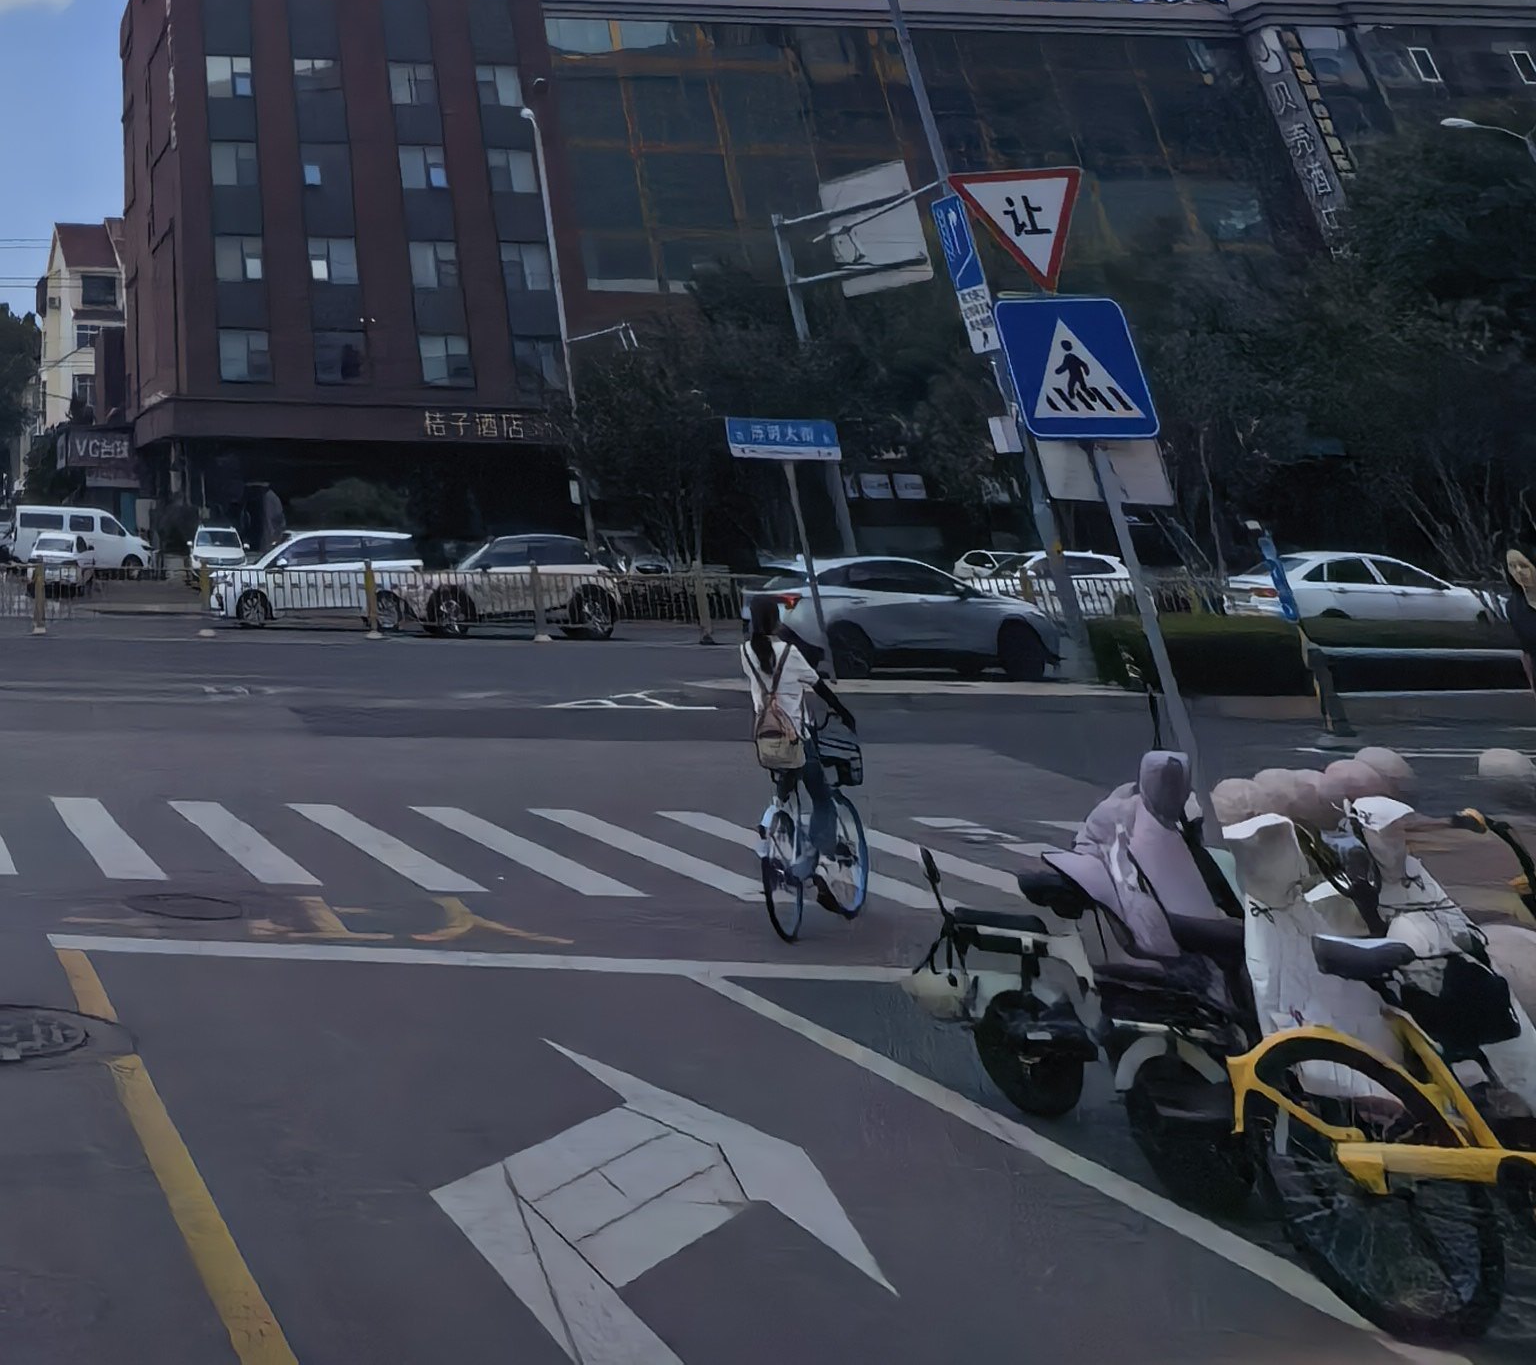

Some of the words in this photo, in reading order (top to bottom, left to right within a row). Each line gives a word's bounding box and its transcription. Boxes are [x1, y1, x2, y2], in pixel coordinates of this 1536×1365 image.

[1003, 195, 1052, 236] 让
[424, 411, 524, 438] 桔子酒店
